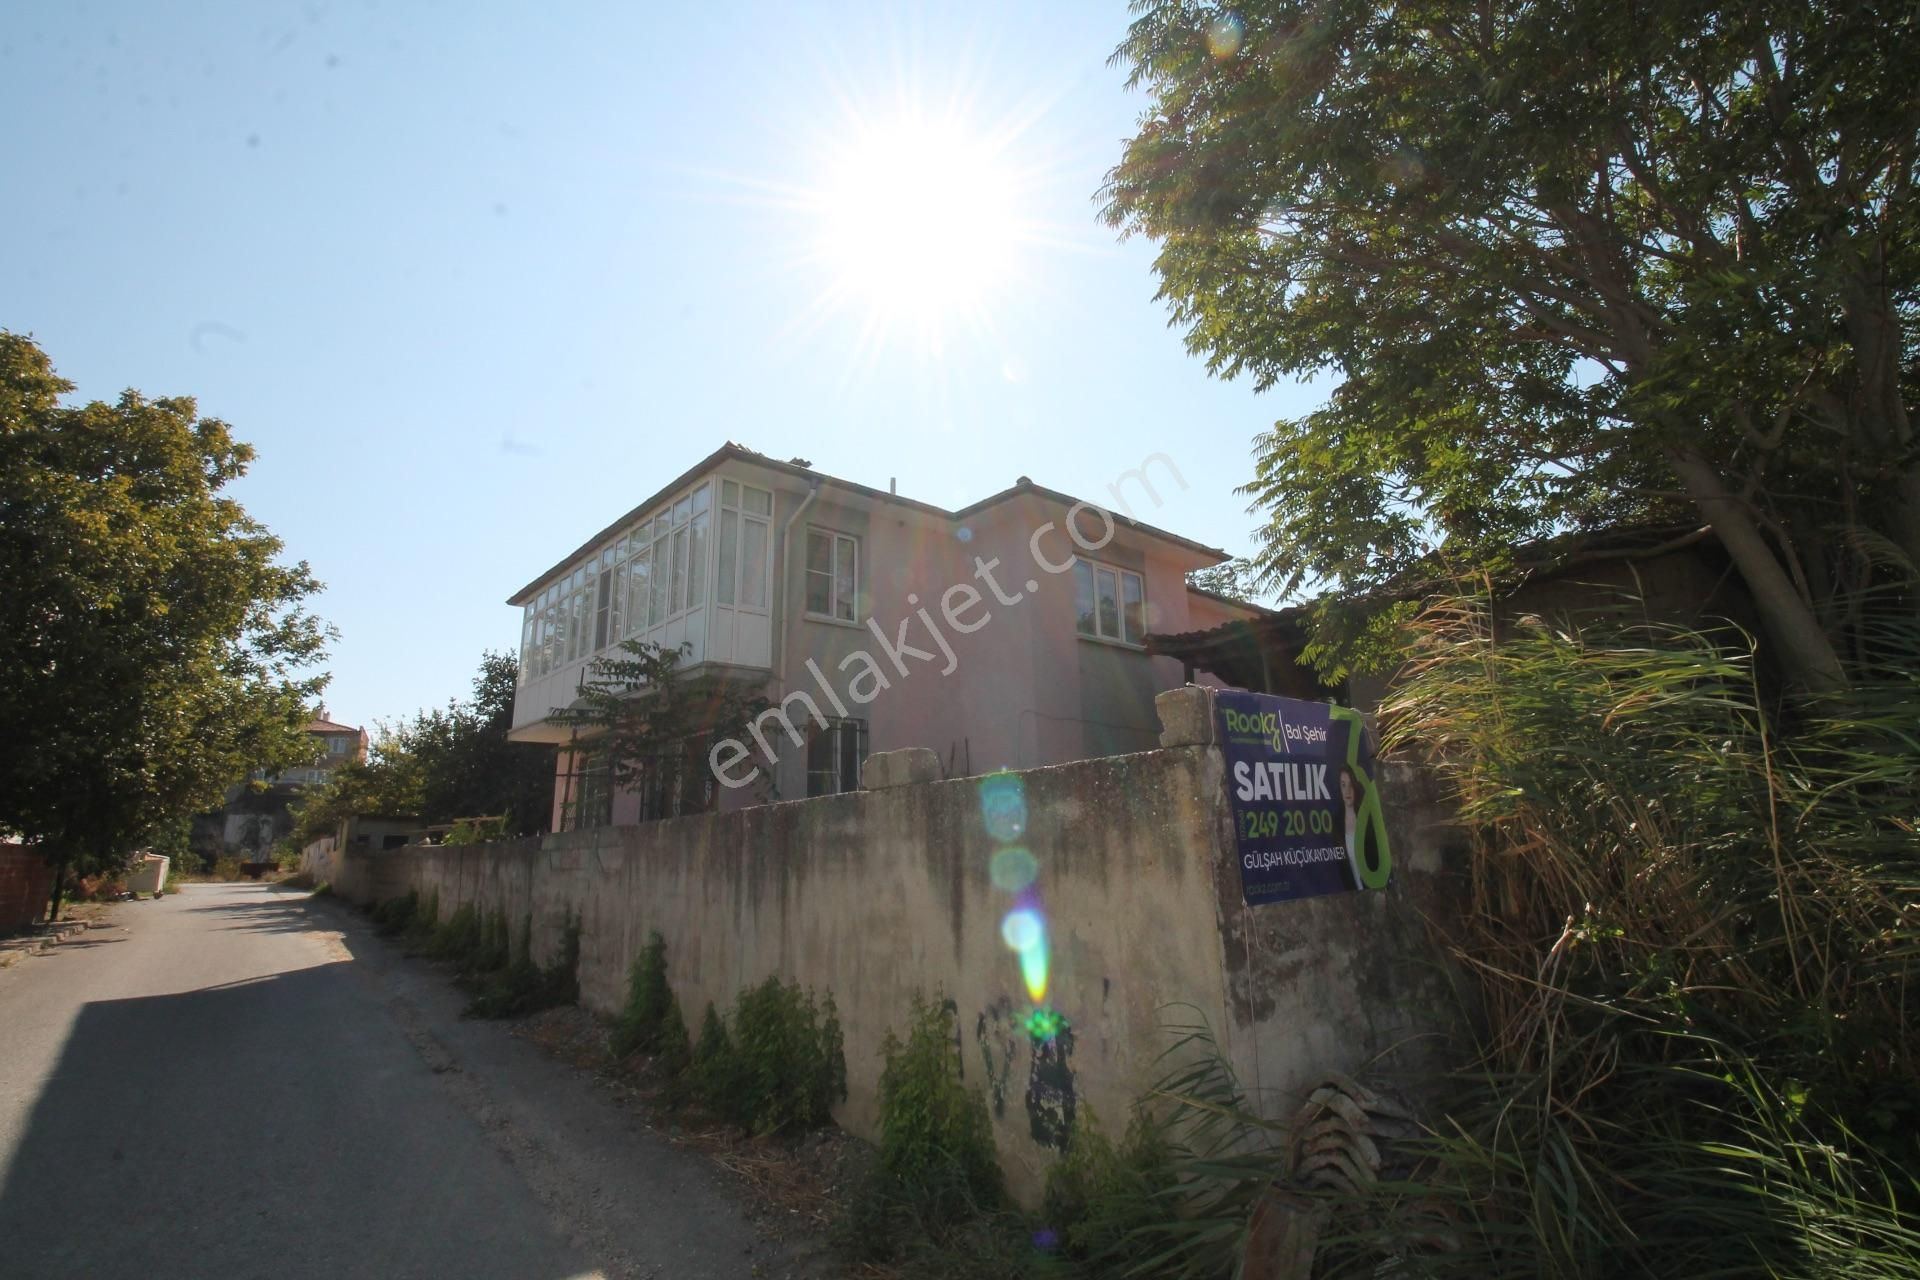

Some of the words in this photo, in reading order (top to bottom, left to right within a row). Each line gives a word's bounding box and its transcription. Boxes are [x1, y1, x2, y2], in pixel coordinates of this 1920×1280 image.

[1303, 723, 1327, 744] Şehir
[1233, 760, 1331, 801] SATILIK
[1246, 810, 1278, 838] 249
[1282, 809, 1306, 836] 20
[1309, 808, 1333, 834] 00
[1244, 849, 1283, 871] GÜLŞAH
[1283, 846, 1345, 868] KÜÇÜKAYDINER
